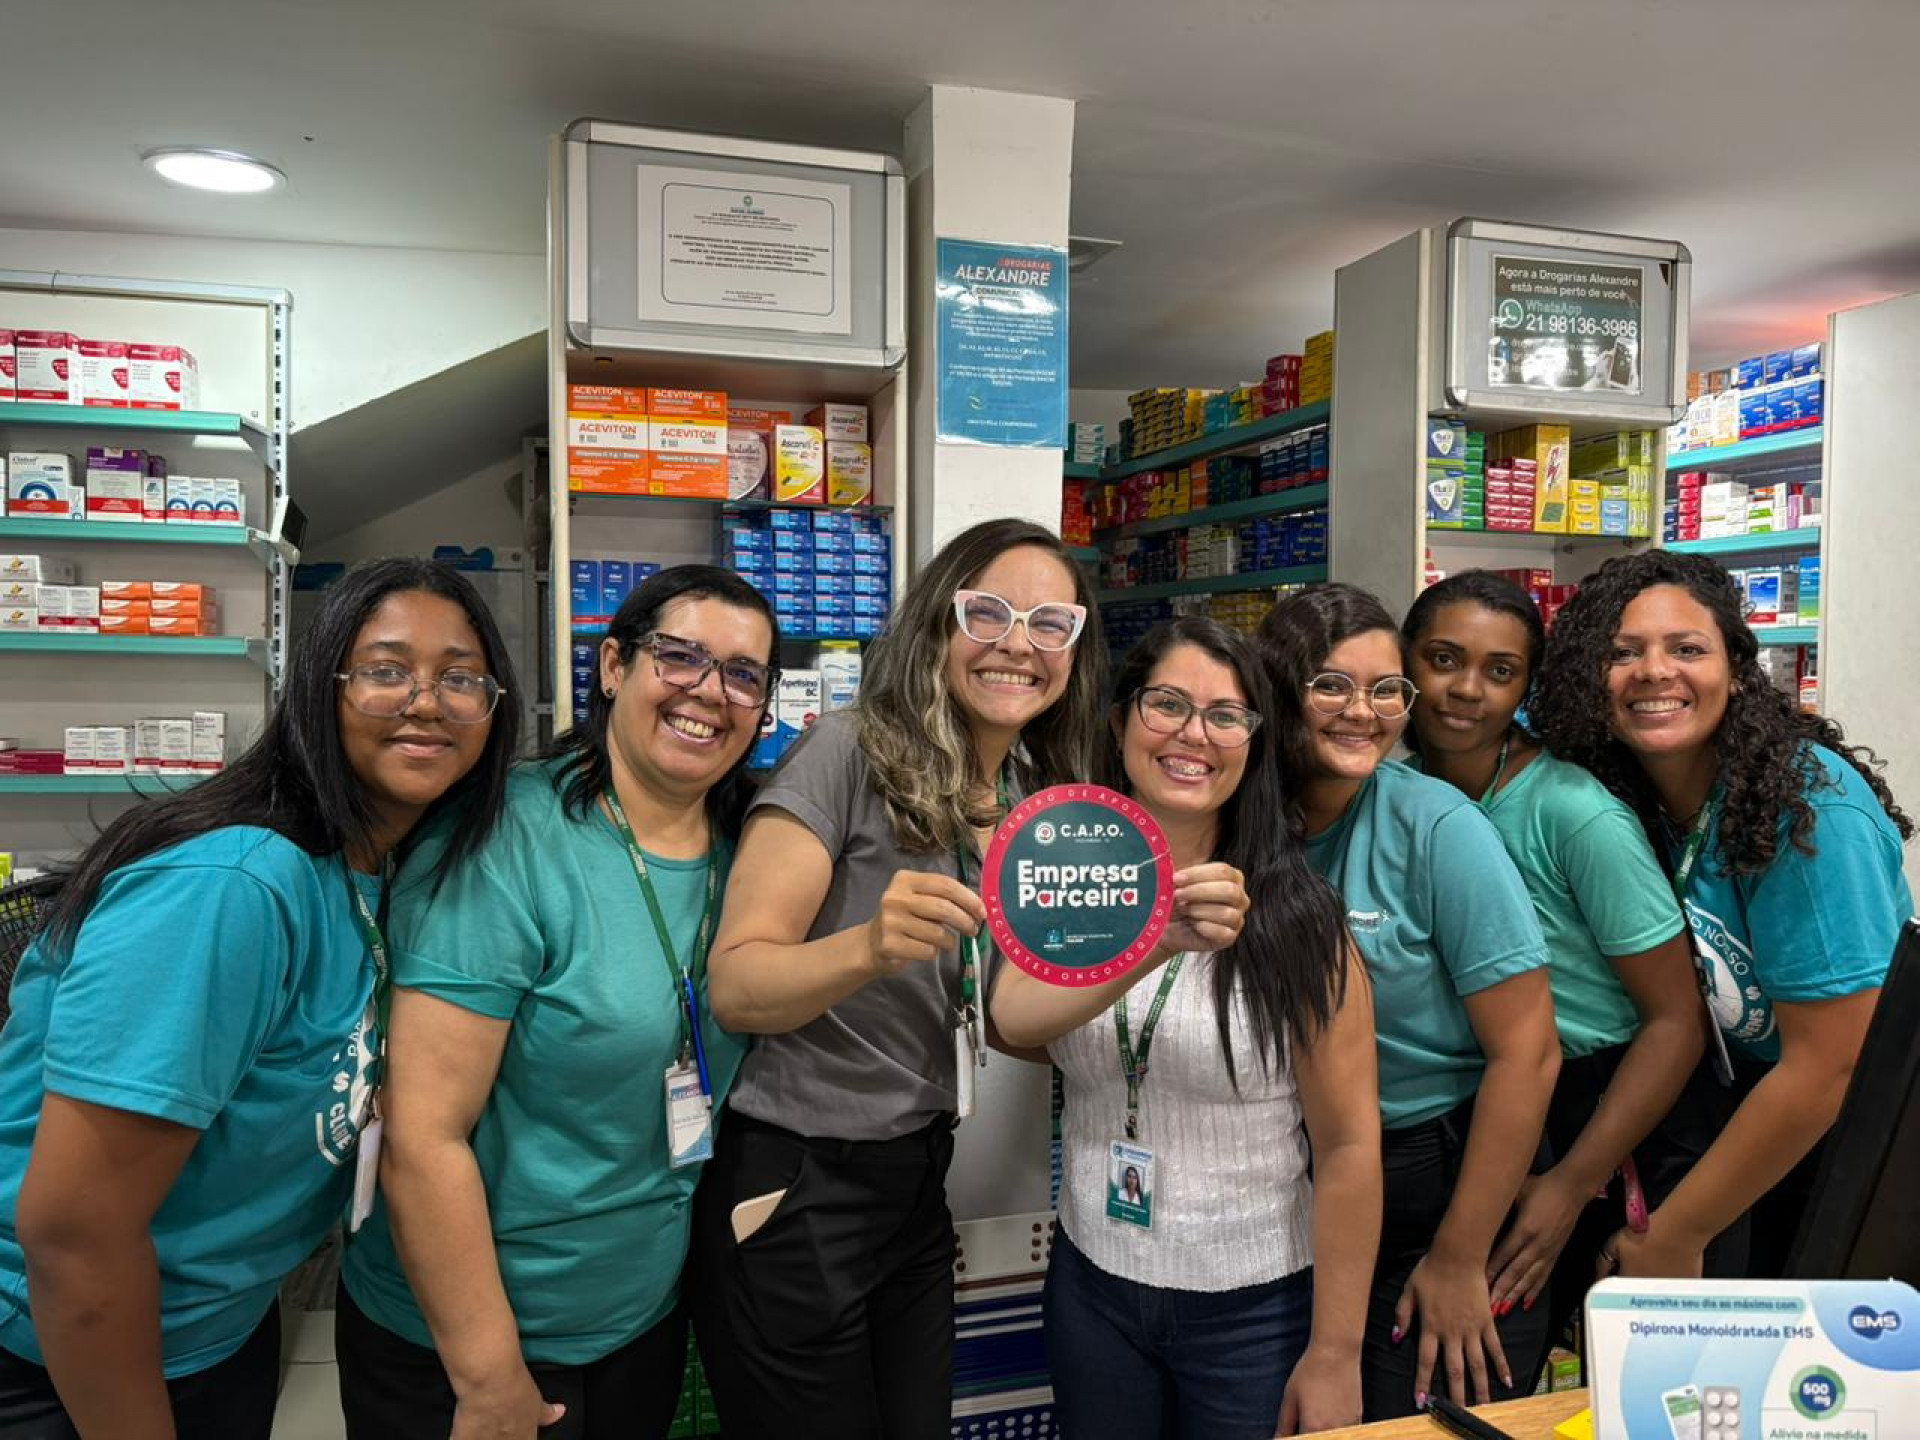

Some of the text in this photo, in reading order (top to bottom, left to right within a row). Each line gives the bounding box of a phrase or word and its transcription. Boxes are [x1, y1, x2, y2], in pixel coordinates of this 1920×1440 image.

[954, 264, 1051, 286] ALEXANDRE
[1499, 266, 1528, 279] Agora
[1539, 269, 1587, 283] Drogarias
[1589, 273, 1639, 286] Alexandre
[1510, 282, 1532, 292] está
[1534, 285, 1557, 294] mais
[1560, 286, 1586, 297] perto
[1588, 288, 1600, 297] de
[1525, 300, 1582, 315] WhatsApp
[1526, 313, 1638, 337] 21 98136-3986
[573, 386, 621, 395] ACEVITON
[654, 390, 702, 398] ACEVITON
[578, 423, 637, 433] ACEVITON
[660, 429, 717, 438] ACEVITON
[1001, 794, 1055, 841] CENTRO
[1068, 789, 1088, 797] DE
[1100, 793, 1146, 825] APOIO
[1060, 824, 1124, 837] C.A.P.O.
[1017, 860, 1138, 888] Empresa
[1019, 882, 1138, 908] Parceira
[990, 896, 1050, 975] PACIENTES
[1630, 1296, 1678, 1309] Aproveite
[1682, 1301, 1699, 1309] seu
[1702, 1299, 1717, 1309] dia
[1719, 1301, 1731, 1309] ao
[1734, 1298, 1773, 1309] máximo
[1852, 1314, 1898, 1328] EMS
[1630, 1322, 1815, 1338] Dipirona Monoidratada EMS
[1803, 1383, 1829, 1395] 500
[1813, 1396, 1831, 1407] mg
[1806, 1431, 1820, 1439] na
[1824, 1428, 1867, 1439] medida
